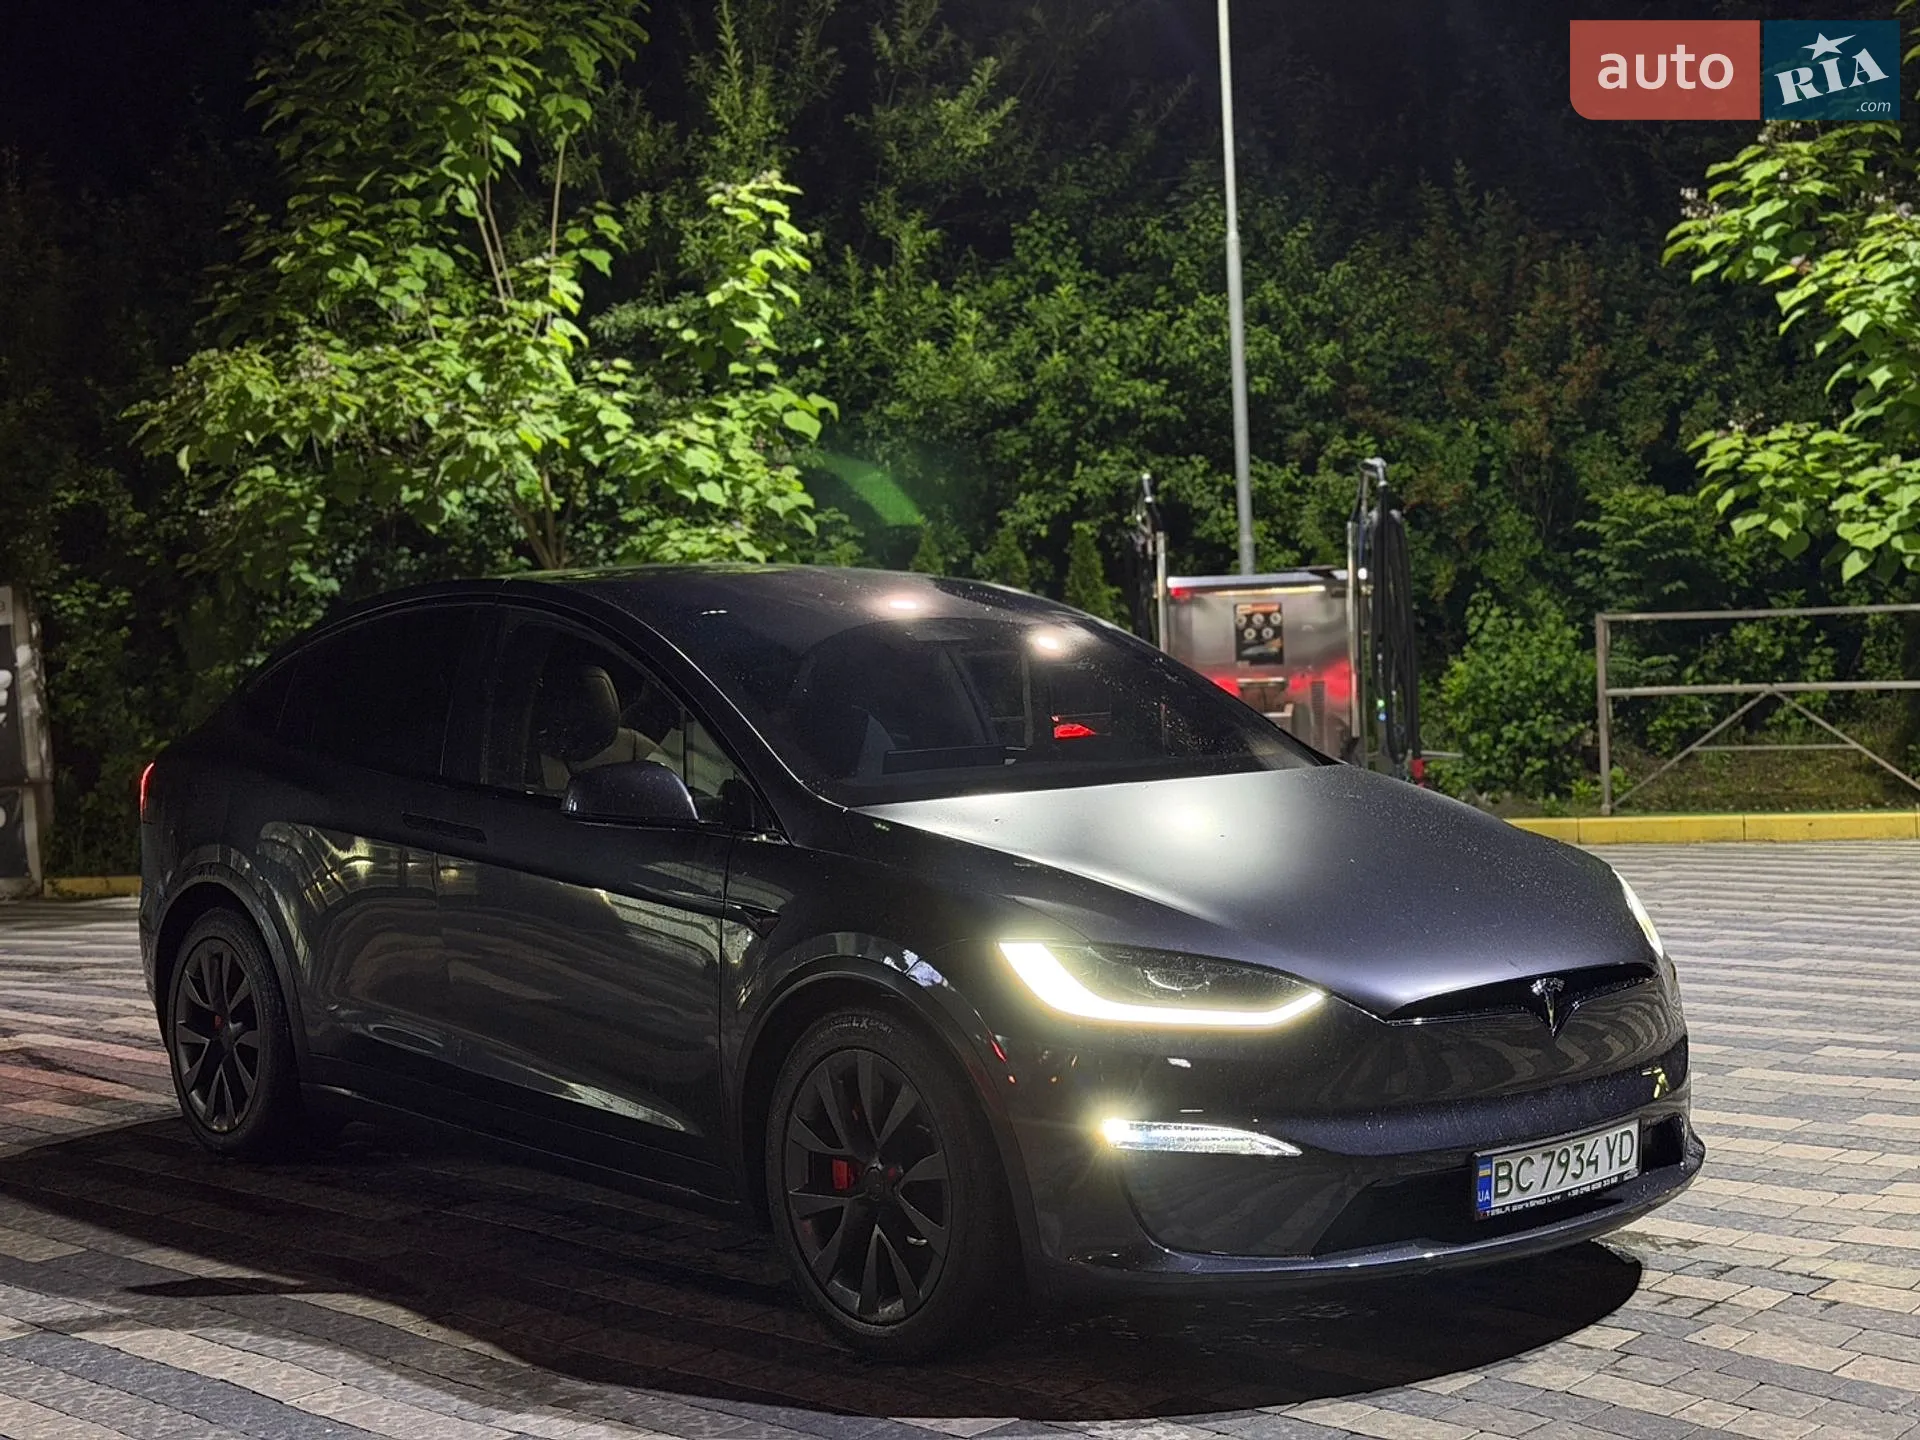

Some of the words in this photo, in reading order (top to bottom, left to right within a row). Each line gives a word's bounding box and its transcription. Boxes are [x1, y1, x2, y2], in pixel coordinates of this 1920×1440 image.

[1493, 1156, 1535, 1200] BC
[1541, 1138, 1600, 1190] 7934
[1605, 1129, 1635, 1171] YD
[1477, 1190, 1491, 1203] UA
